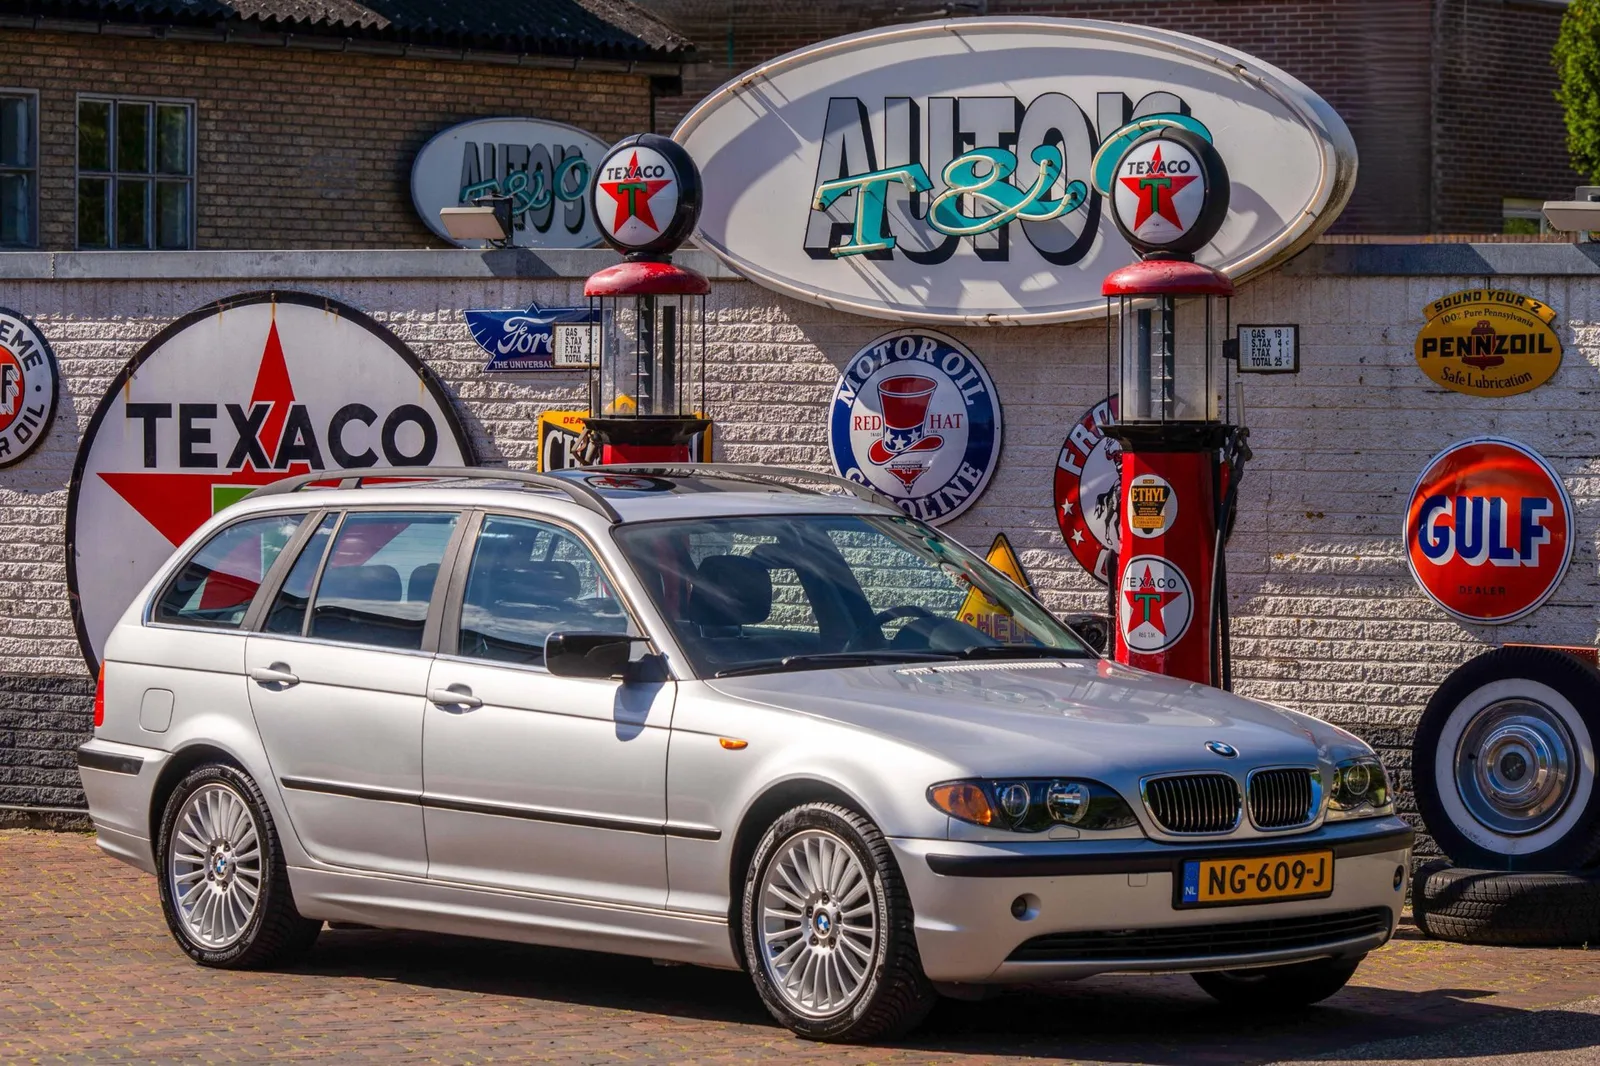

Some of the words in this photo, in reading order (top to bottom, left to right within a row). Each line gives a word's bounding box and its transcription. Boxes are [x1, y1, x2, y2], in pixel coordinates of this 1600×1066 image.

[606, 165, 665, 180] TEXACO
[1127, 160, 1191, 175] TEXACO
[803, 91, 1192, 266] AUTO'
[1434, 291, 1482, 313] SOUND
[1487, 291, 1526, 307] YOUR
[1529, 301, 1543, 314] Z
[1463, 309, 1483, 318] Pure
[1484, 308, 1534, 328] Pennsylvania
[565, 328, 578, 336] GAS
[1251, 329, 1266, 338] GAS
[1274, 329, 1282, 338] 19
[0, 319, 43, 371] EME
[1251, 339, 1272, 348] S.TAX
[1421, 332, 1553, 359] PENNZOIL
[565, 355, 582, 363] TOTAL
[1251, 348, 1271, 357] F.TAX
[493, 361, 509, 369] THE
[1251, 358, 1272, 367] TOTAL
[1274, 358, 1283, 367] 25
[838, 336, 938, 409] MOTOR
[941, 352, 986, 406] OIL
[1441, 366, 1466, 387] Safe
[1467, 371, 1533, 389] Lubrication
[13, 403, 45, 445] OIL
[854, 415, 882, 431] RED
[929, 414, 964, 429] HAT
[126, 402, 438, 470] TEXACO
[846, 461, 982, 521] GOLINE
[1132, 487, 1167, 502] ETHYL
[1418, 494, 1554, 568] GULF
[1126, 577, 1177, 589] TEXACO
[1459, 585, 1507, 596] DEALER
[1208, 857, 1326, 896] NG-609-J
[1185, 887, 1197, 896] NL
